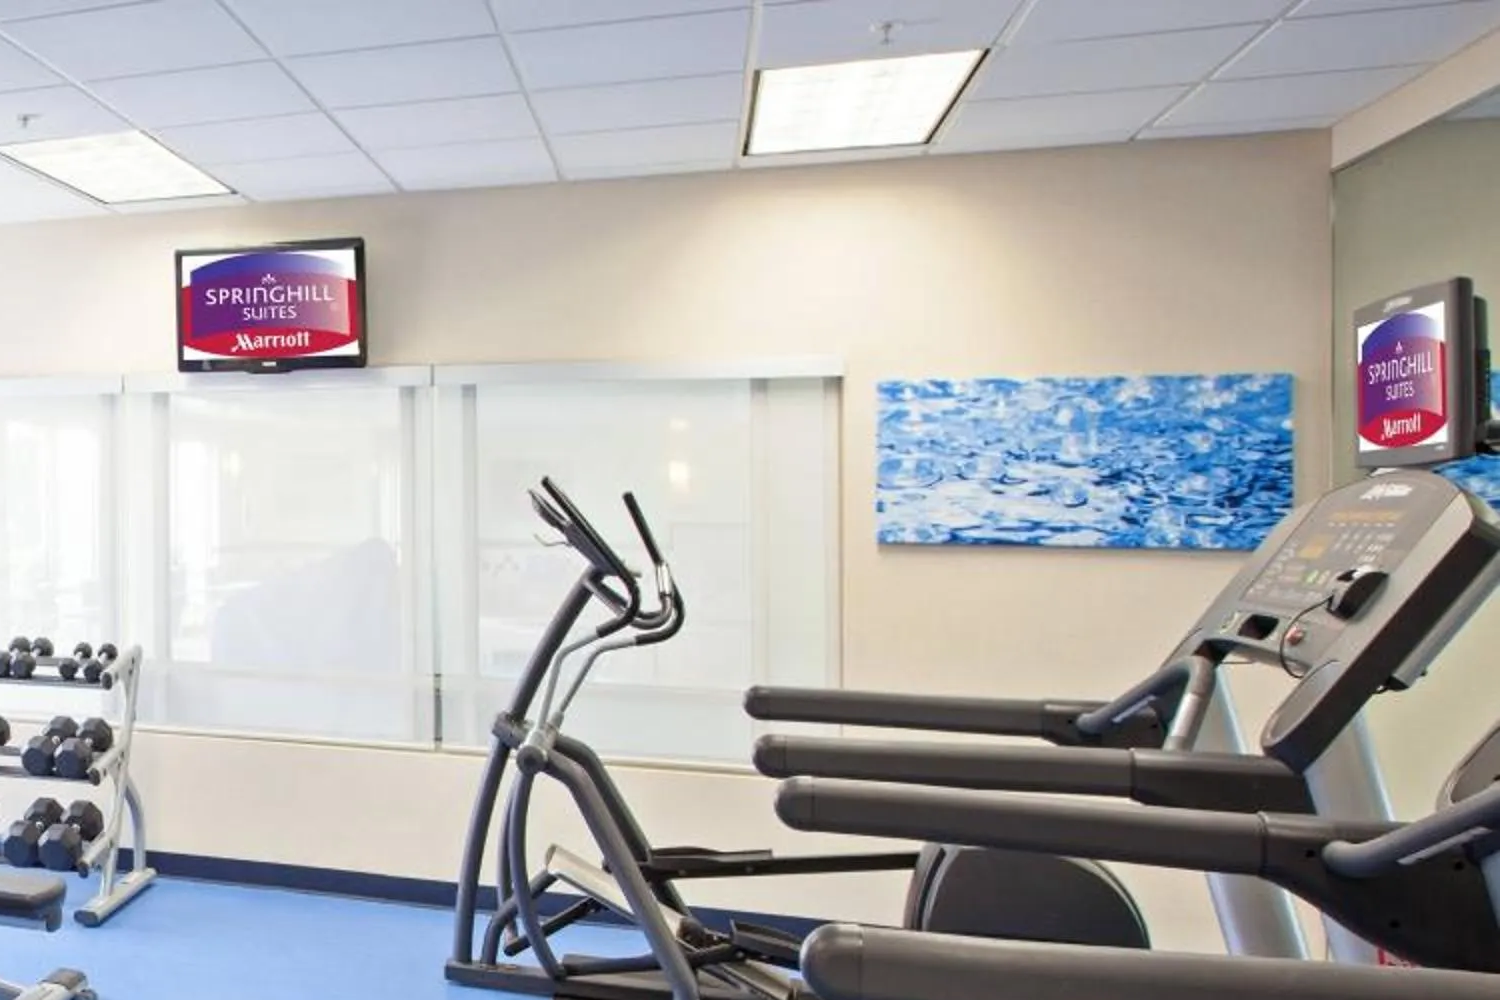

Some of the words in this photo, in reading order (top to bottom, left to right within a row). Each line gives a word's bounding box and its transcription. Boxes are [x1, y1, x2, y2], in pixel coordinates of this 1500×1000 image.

[205, 284, 336, 306] SPRINGHILL
[243, 305, 297, 321] SUITES
[231, 331, 311, 353] Marriott
[1367, 351, 1434, 385] SPRINGHILL
[1385, 380, 1415, 401] SUITES
